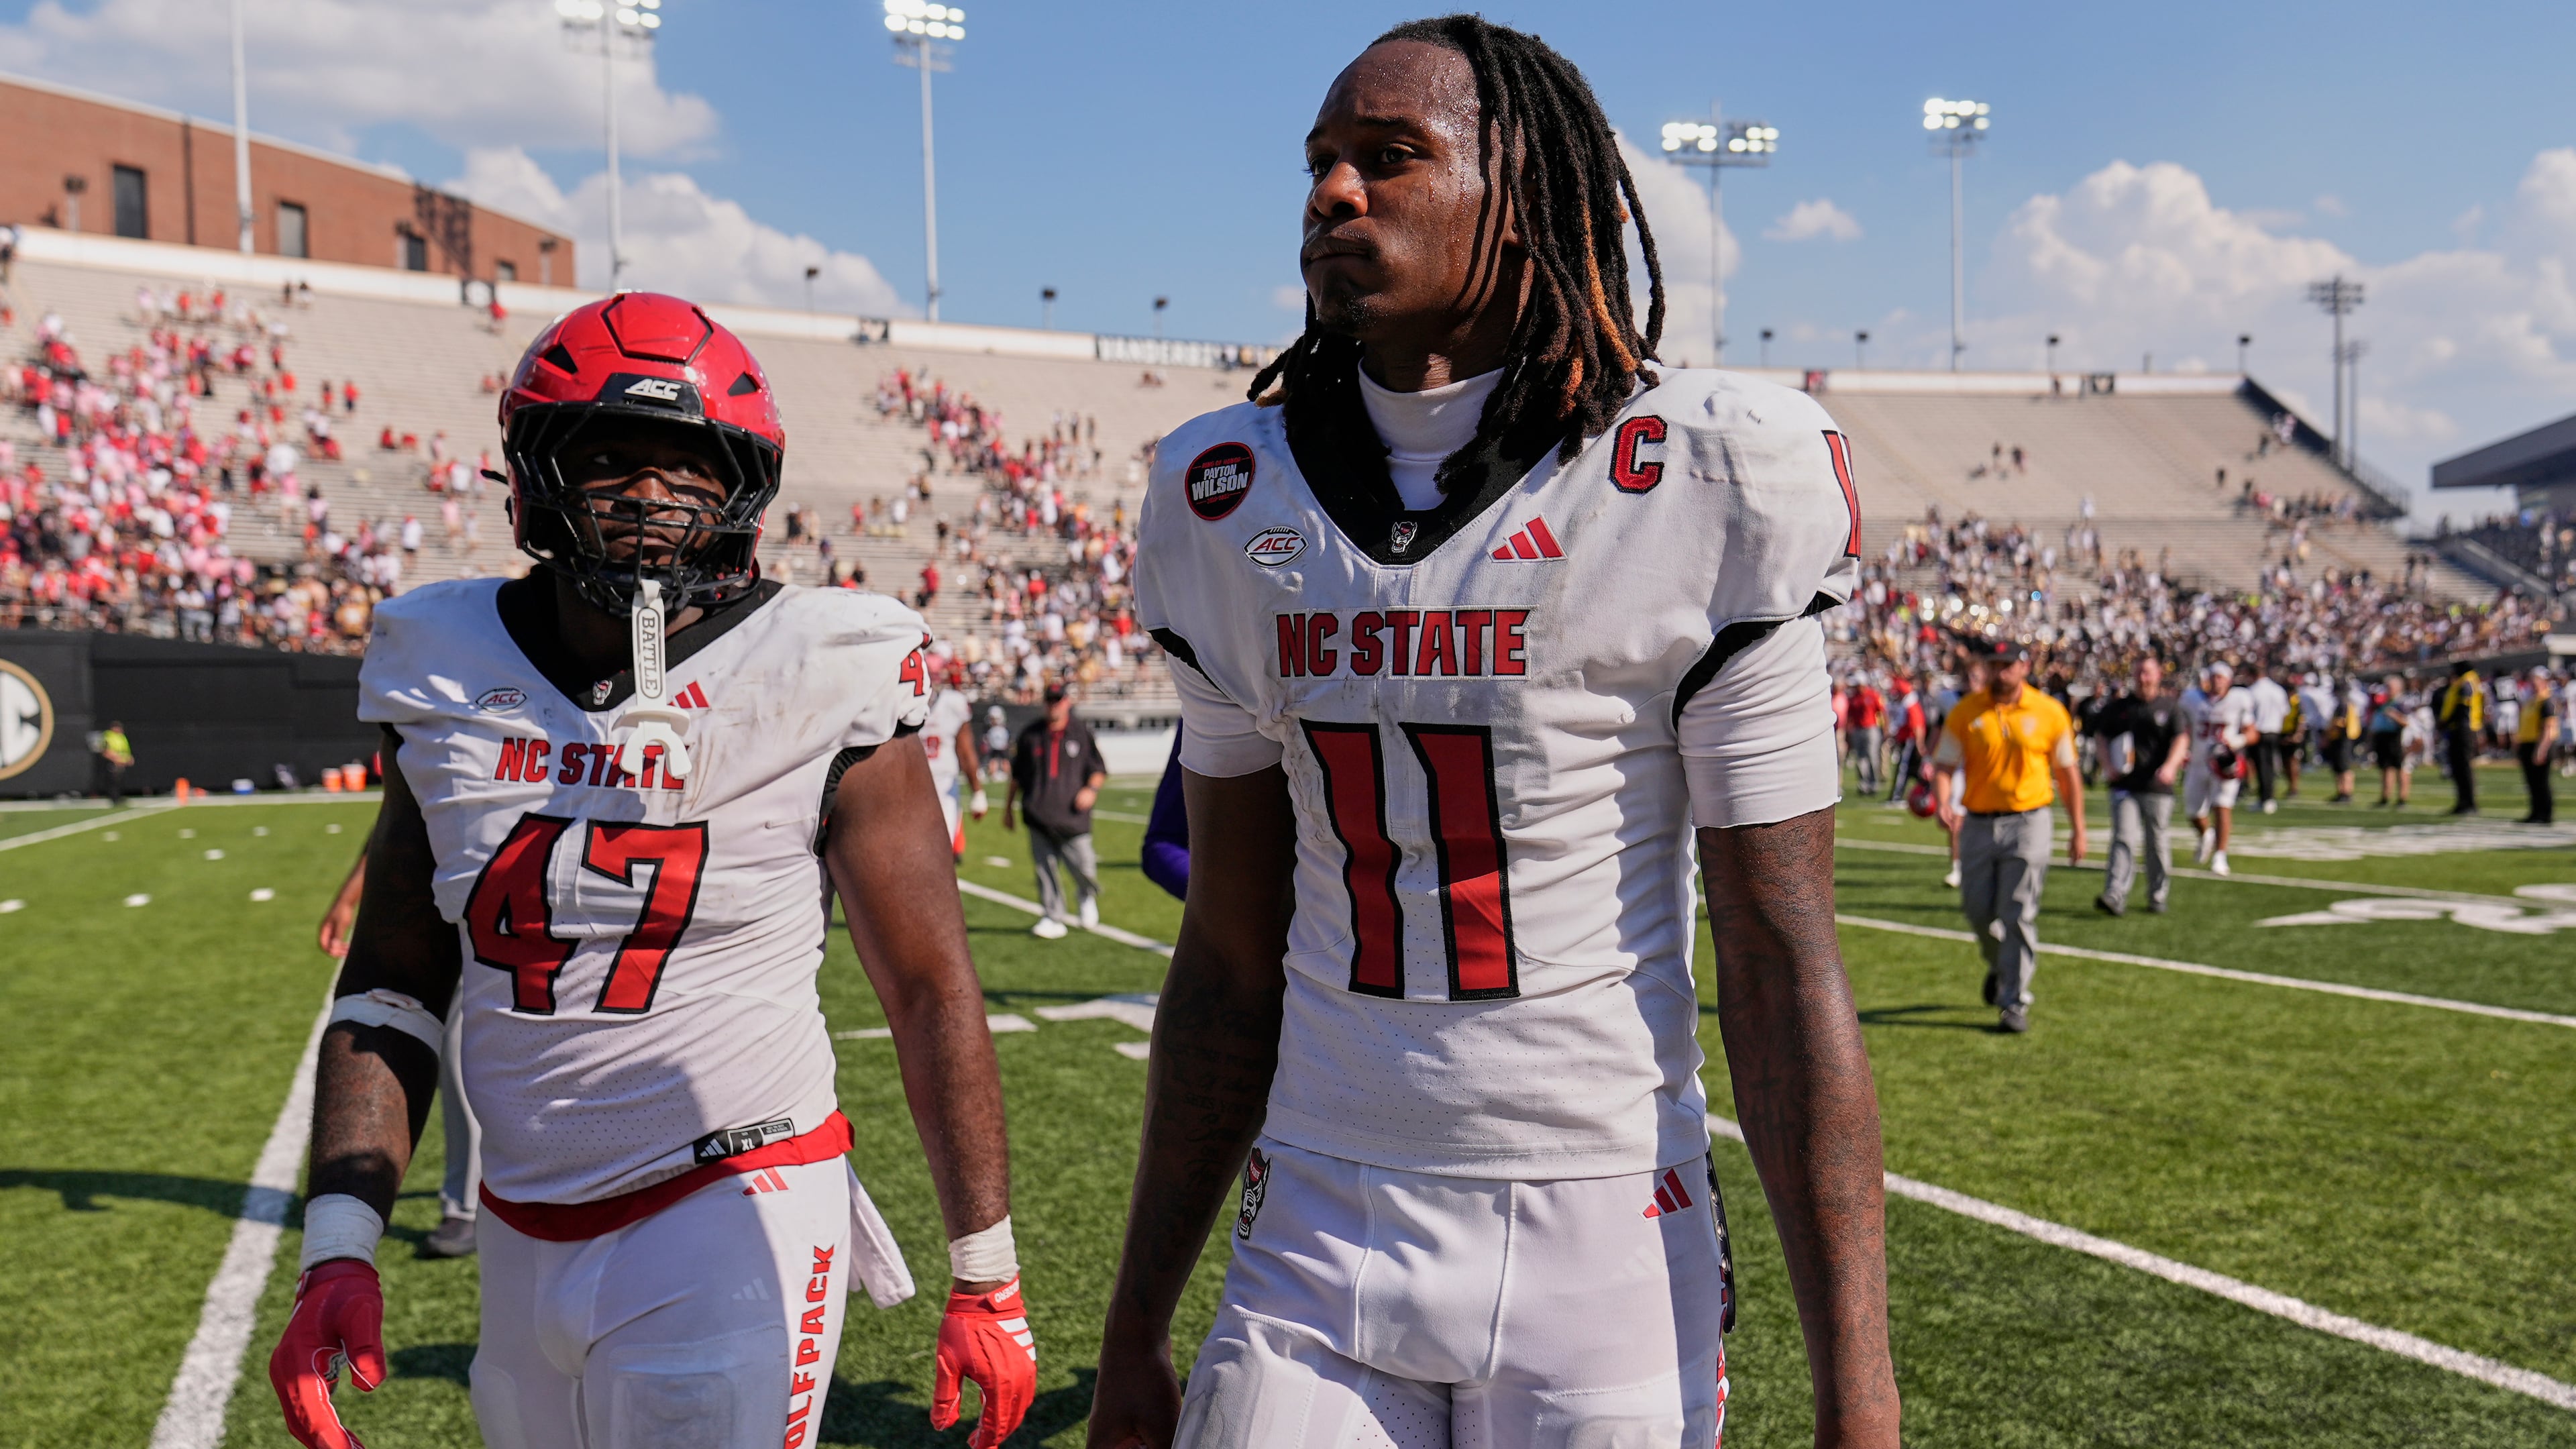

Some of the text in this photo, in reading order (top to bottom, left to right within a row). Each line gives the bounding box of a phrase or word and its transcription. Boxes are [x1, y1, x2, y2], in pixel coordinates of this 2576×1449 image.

[625, 378, 682, 401] ACC
[1203, 464, 1237, 480] PAYTON
[1610, 415, 1668, 494] C
[1191, 472, 1248, 501] WILSON
[1253, 537, 1301, 552] ACC
[641, 616, 658, 691] BATTLE
[1276, 609, 1532, 678] NC STATE
[484, 692, 521, 705] ACC
[494, 737, 551, 783] NC
[1299, 717, 1521, 1002] 11
[462, 811, 710, 1016] 47
[741, 1138, 756, 1152] XL
